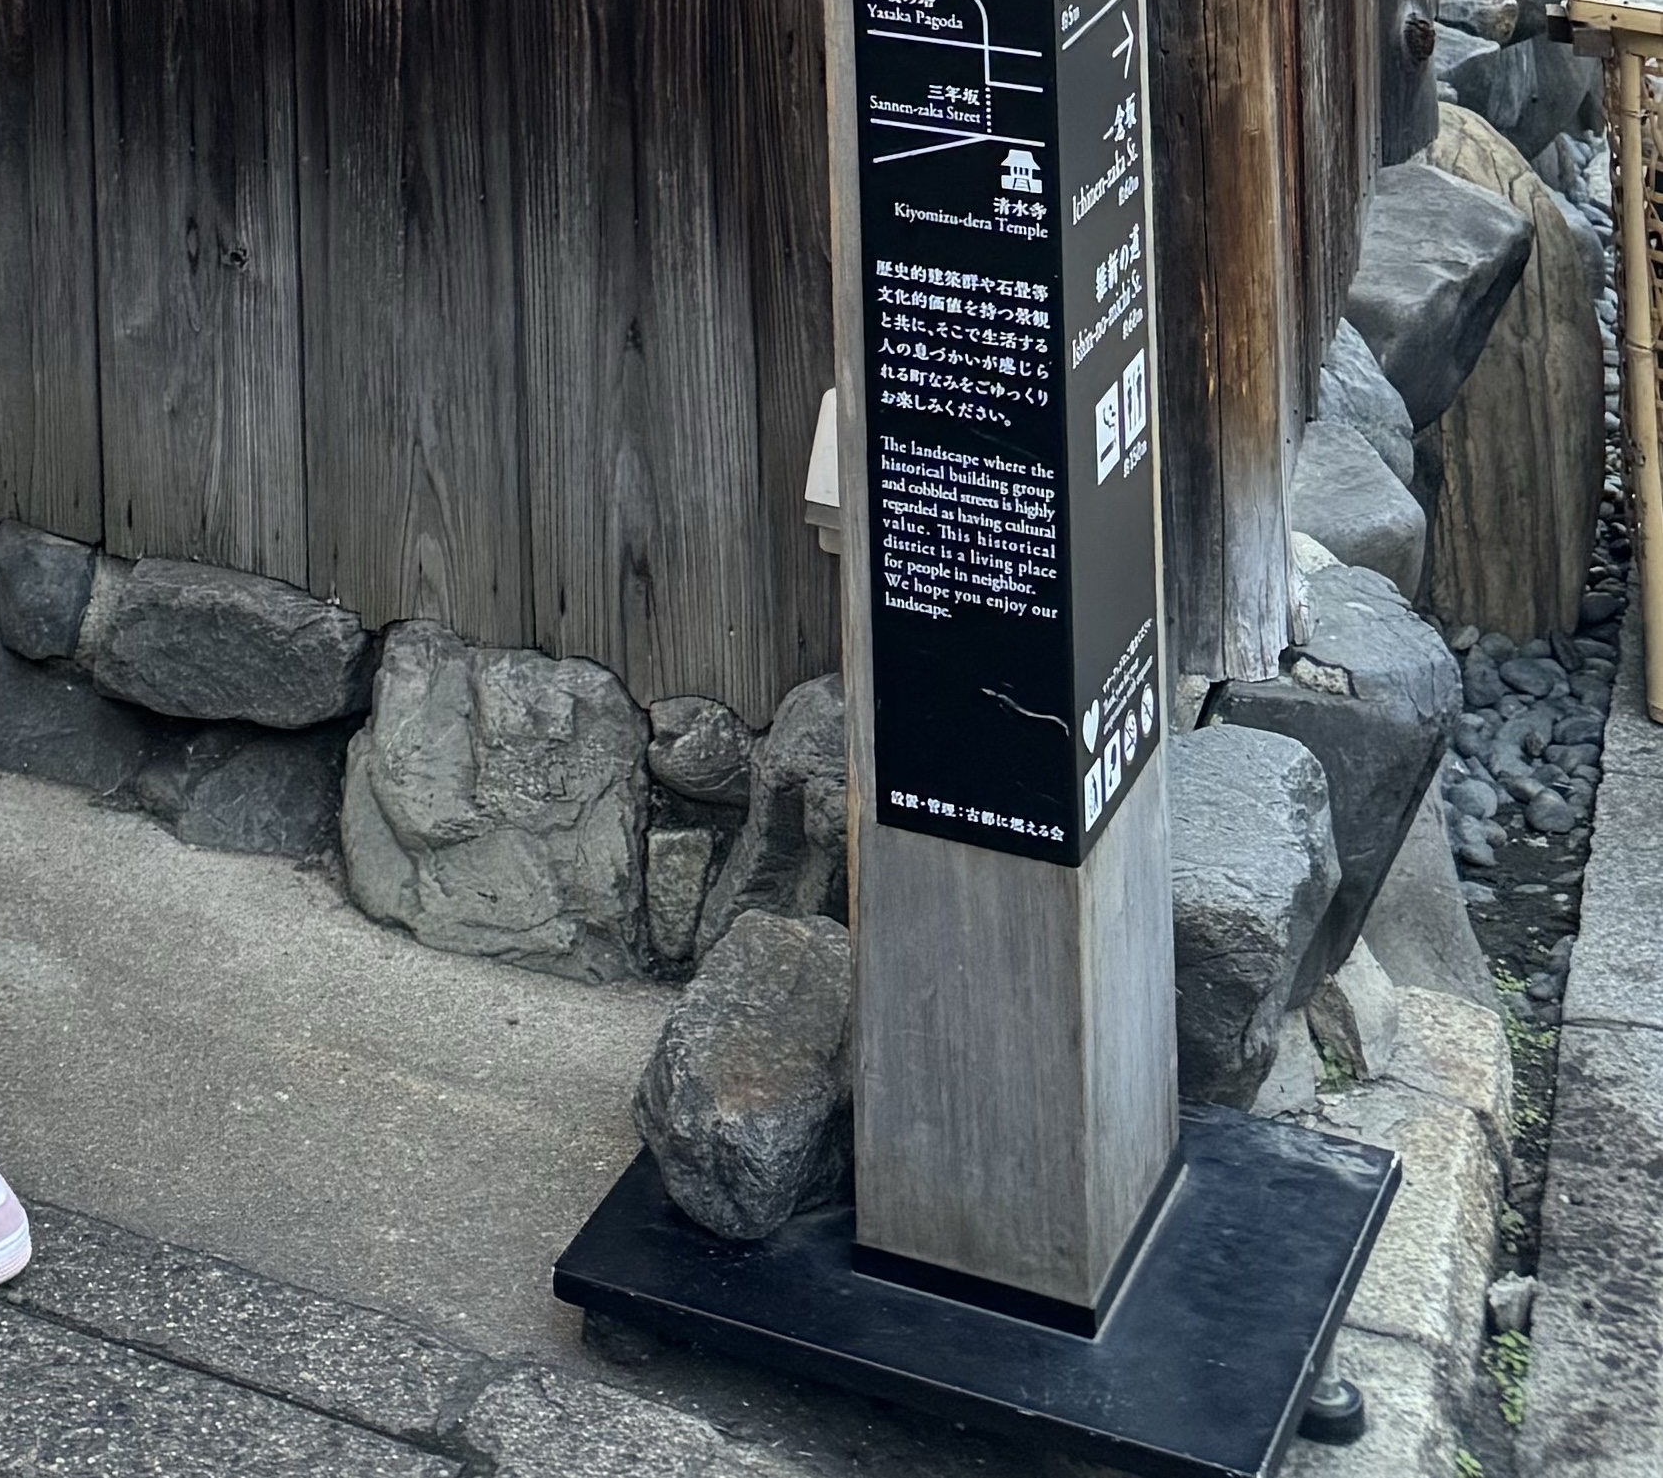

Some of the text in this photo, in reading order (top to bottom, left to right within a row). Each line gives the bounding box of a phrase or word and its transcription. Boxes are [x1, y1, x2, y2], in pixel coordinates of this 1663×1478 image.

[867, 3, 963, 31] Yasaka Pagoda
[870, 95, 981, 124] Sannen-zaka Street
[927, 84, 980, 106] 三年坂
[894, 202, 1049, 240] Kiyomizu-dera Temple
[993, 196, 1047, 220] 清水寺
[877, 286, 1051, 329] 文化的価値を持つ景観
[880, 390, 1011, 427] お楽しみください。
[880, 435, 1054, 479] The landscape where the
[881, 454, 1055, 502] historical building group
[882, 478, 1055, 522] and cobbled streets is highly
[883, 498, 1056, 539] regarded as having cultural
[883, 516, 1056, 559] value. This historical
[883, 534, 1057, 579] district is a living place
[884, 553, 1036, 595] for people in neighbor.
[884, 572, 1058, 619] We hope you enjoy our
[885, 592, 952, 619] landscape.
